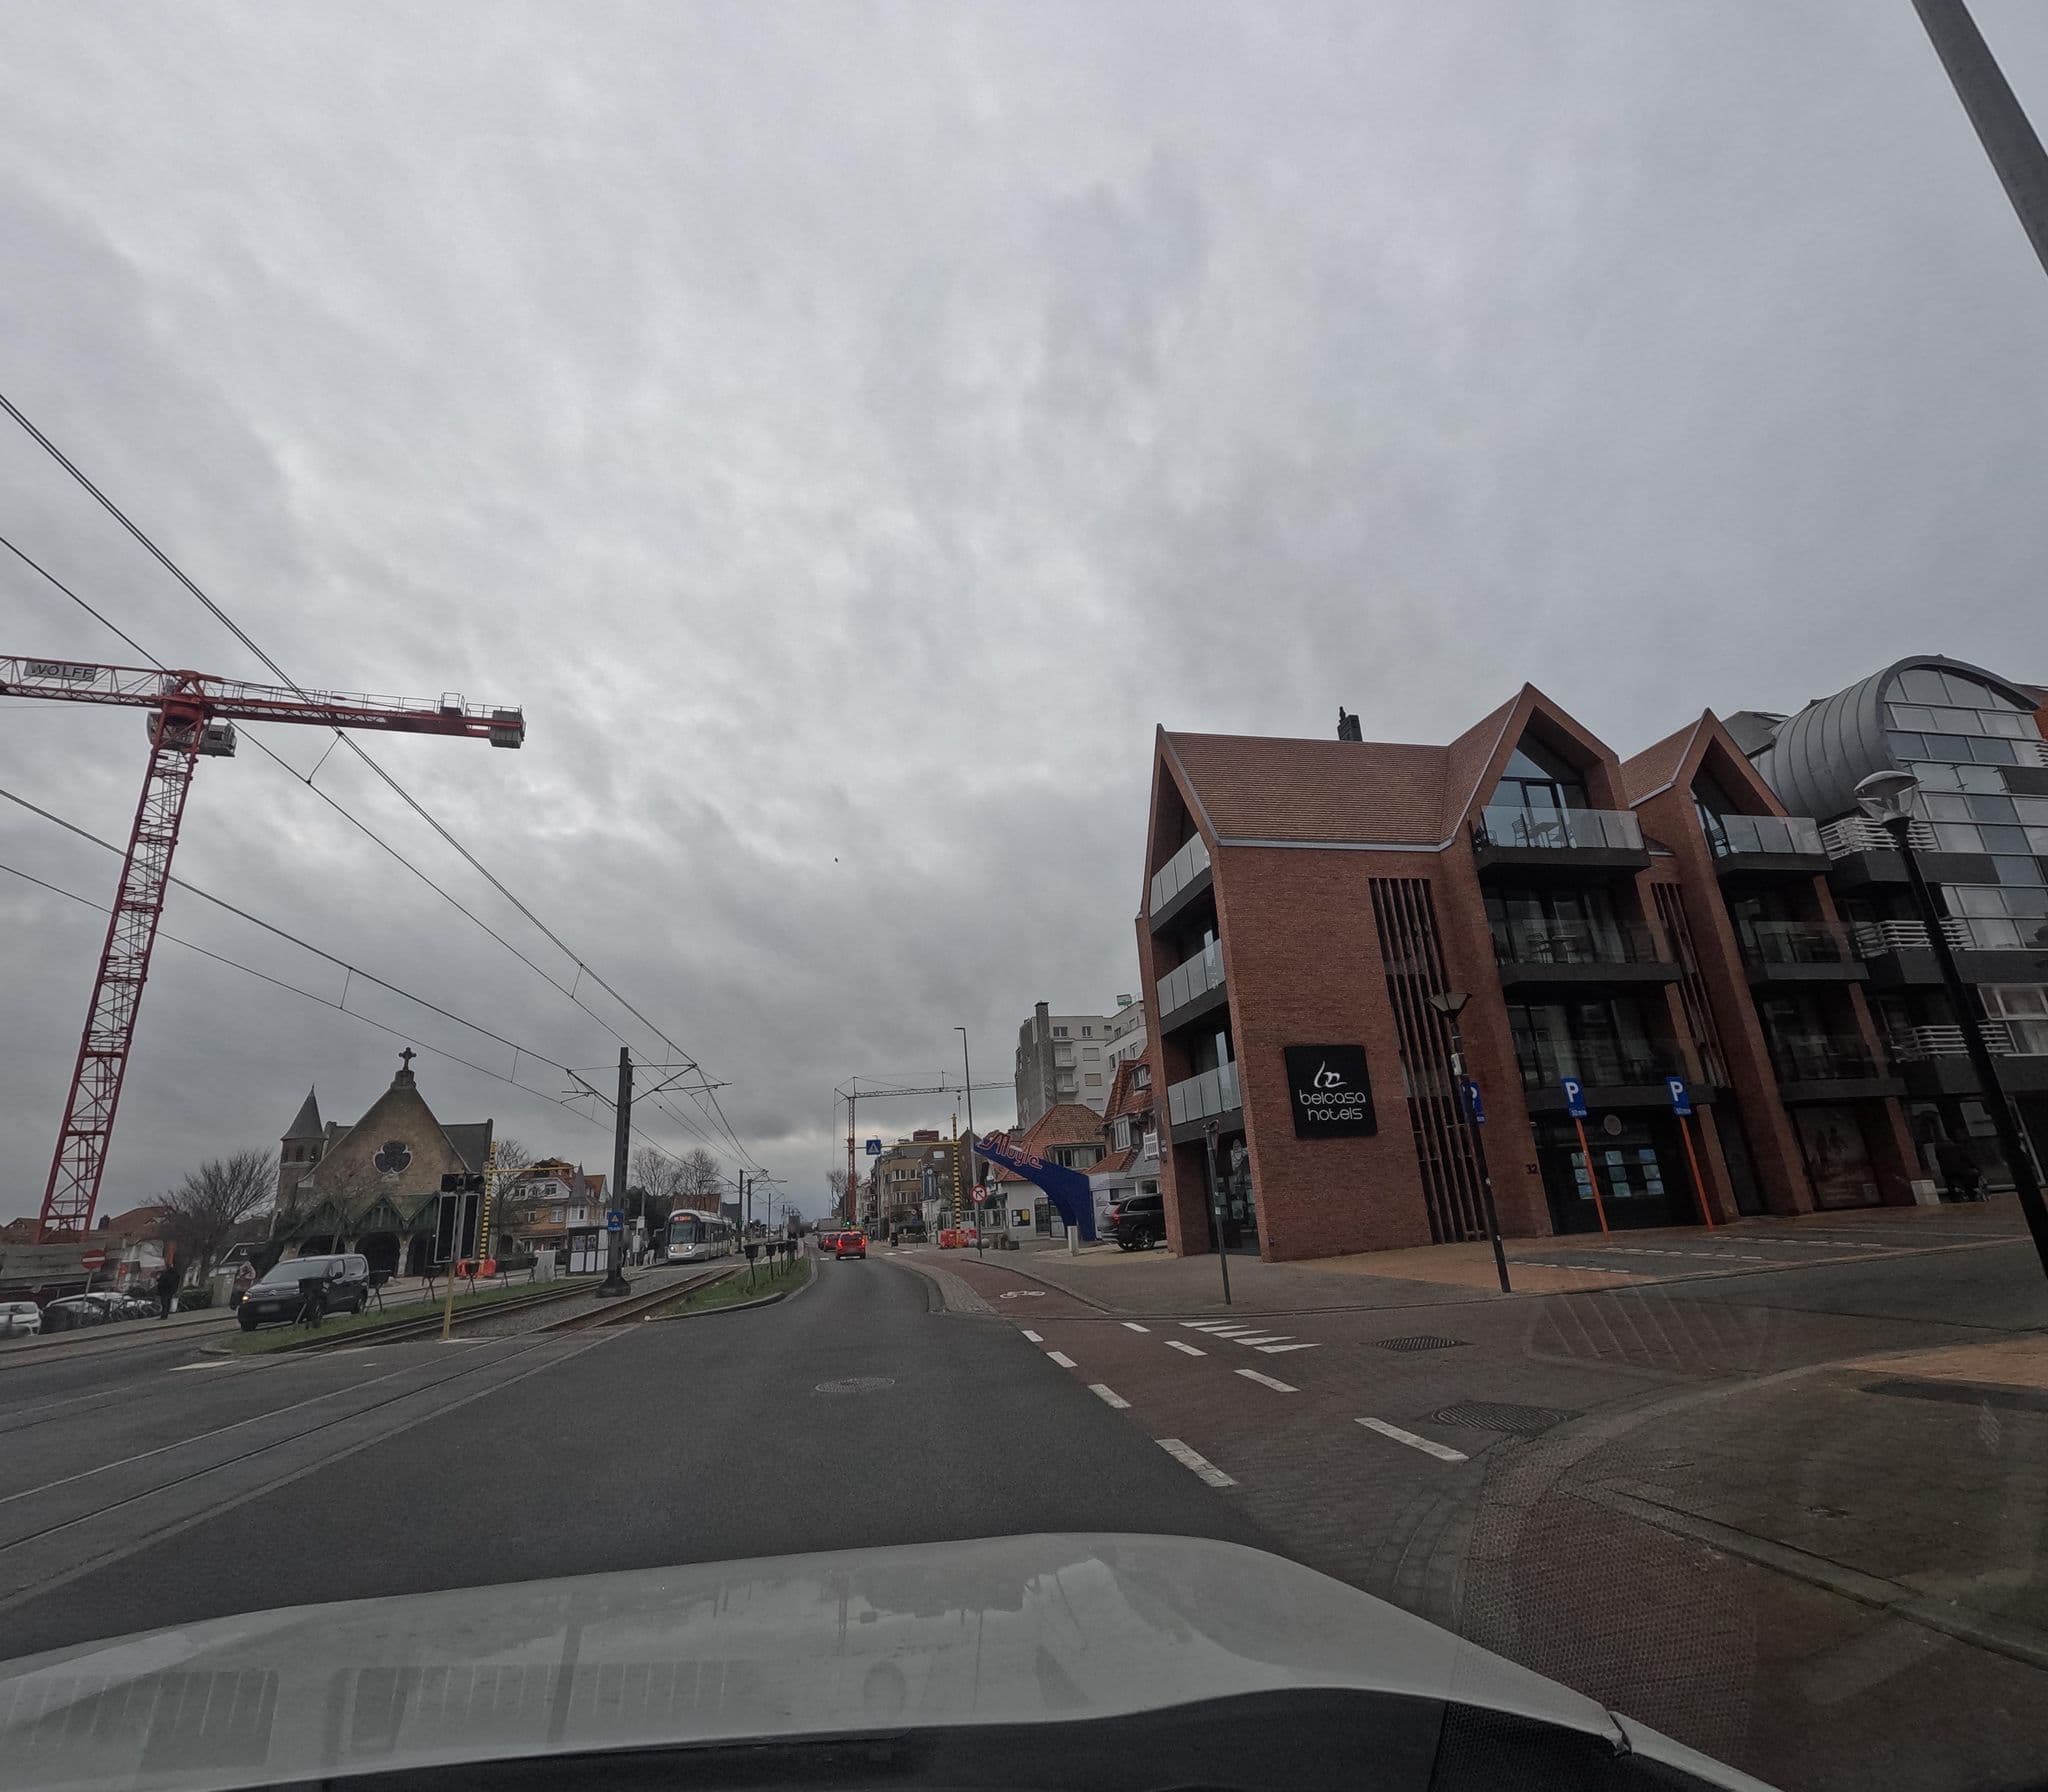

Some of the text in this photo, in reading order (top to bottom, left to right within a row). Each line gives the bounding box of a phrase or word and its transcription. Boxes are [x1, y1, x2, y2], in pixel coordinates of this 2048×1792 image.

[30, 664, 94, 679] WOLFF
[1299, 1089, 1366, 1105] belcasa
[1565, 1081, 1579, 1103] P
[1669, 1081, 1684, 1102] P
[1306, 1107, 1364, 1122] hotels
[1525, 1163, 1539, 1175] 32
